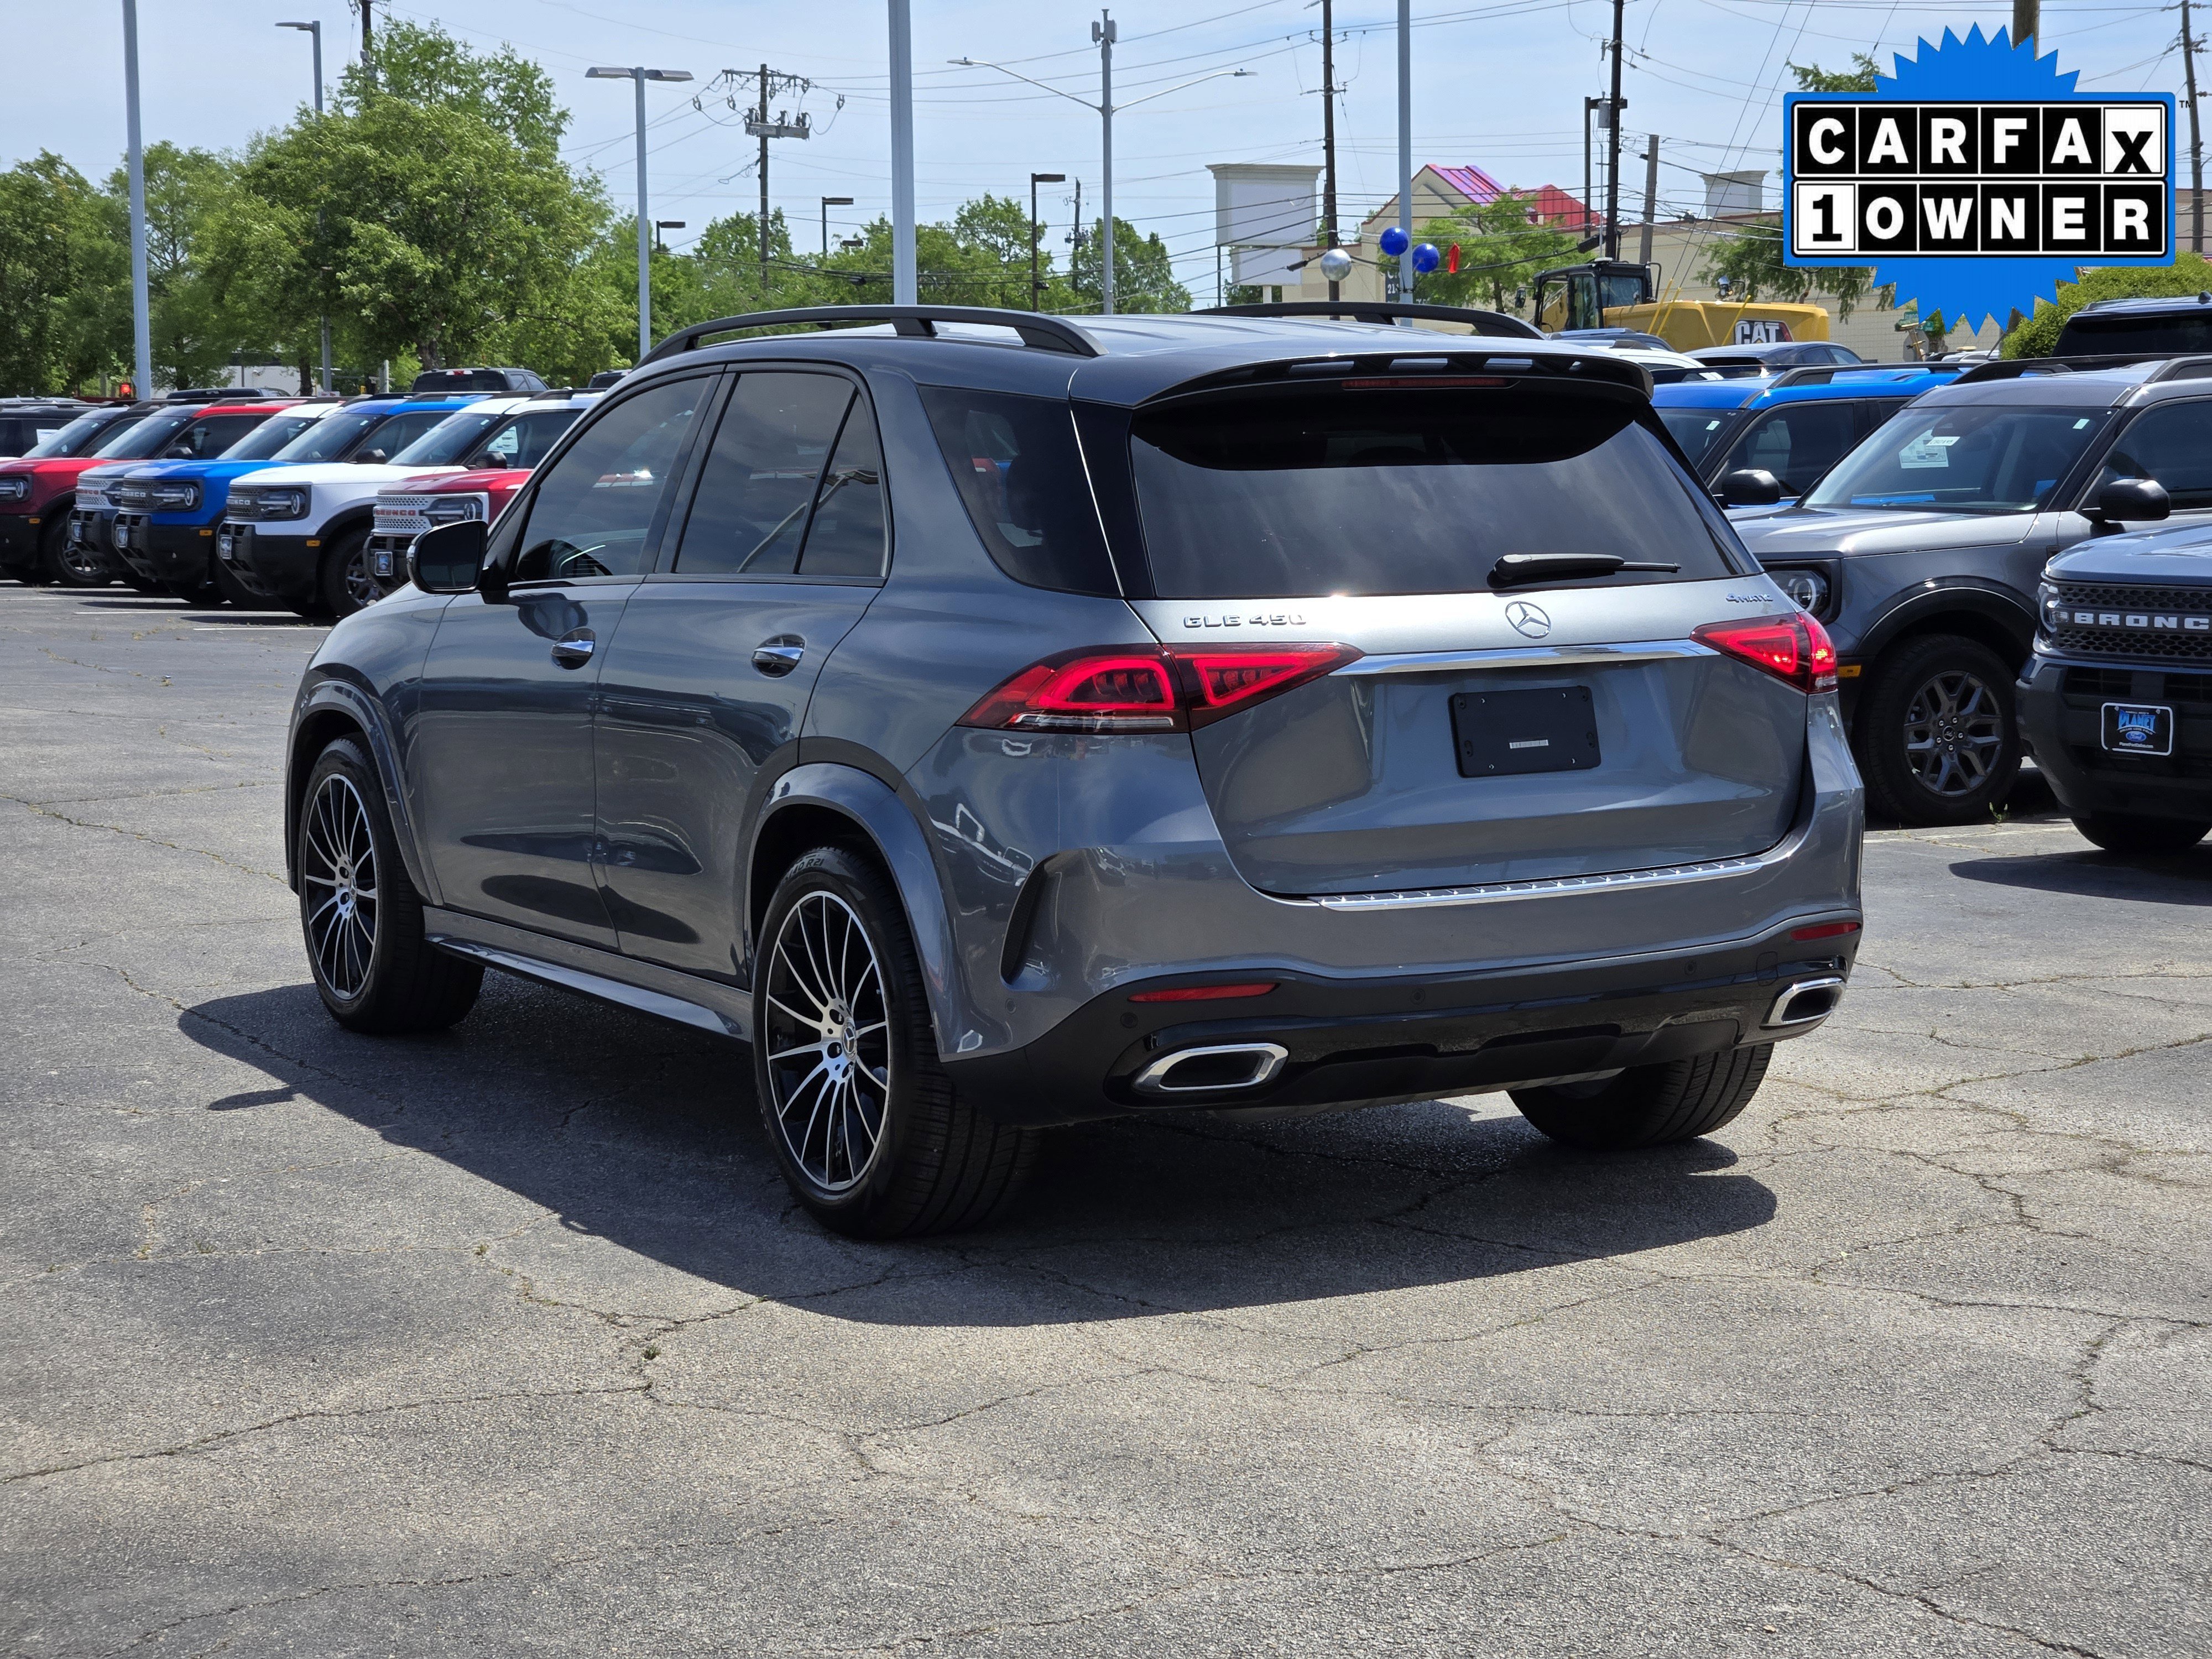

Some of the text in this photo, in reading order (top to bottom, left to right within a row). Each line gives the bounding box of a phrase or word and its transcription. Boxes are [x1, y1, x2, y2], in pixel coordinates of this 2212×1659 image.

[1735, 320, 1780, 345] CAT
[1183, 614, 1307, 629] GLE 450
